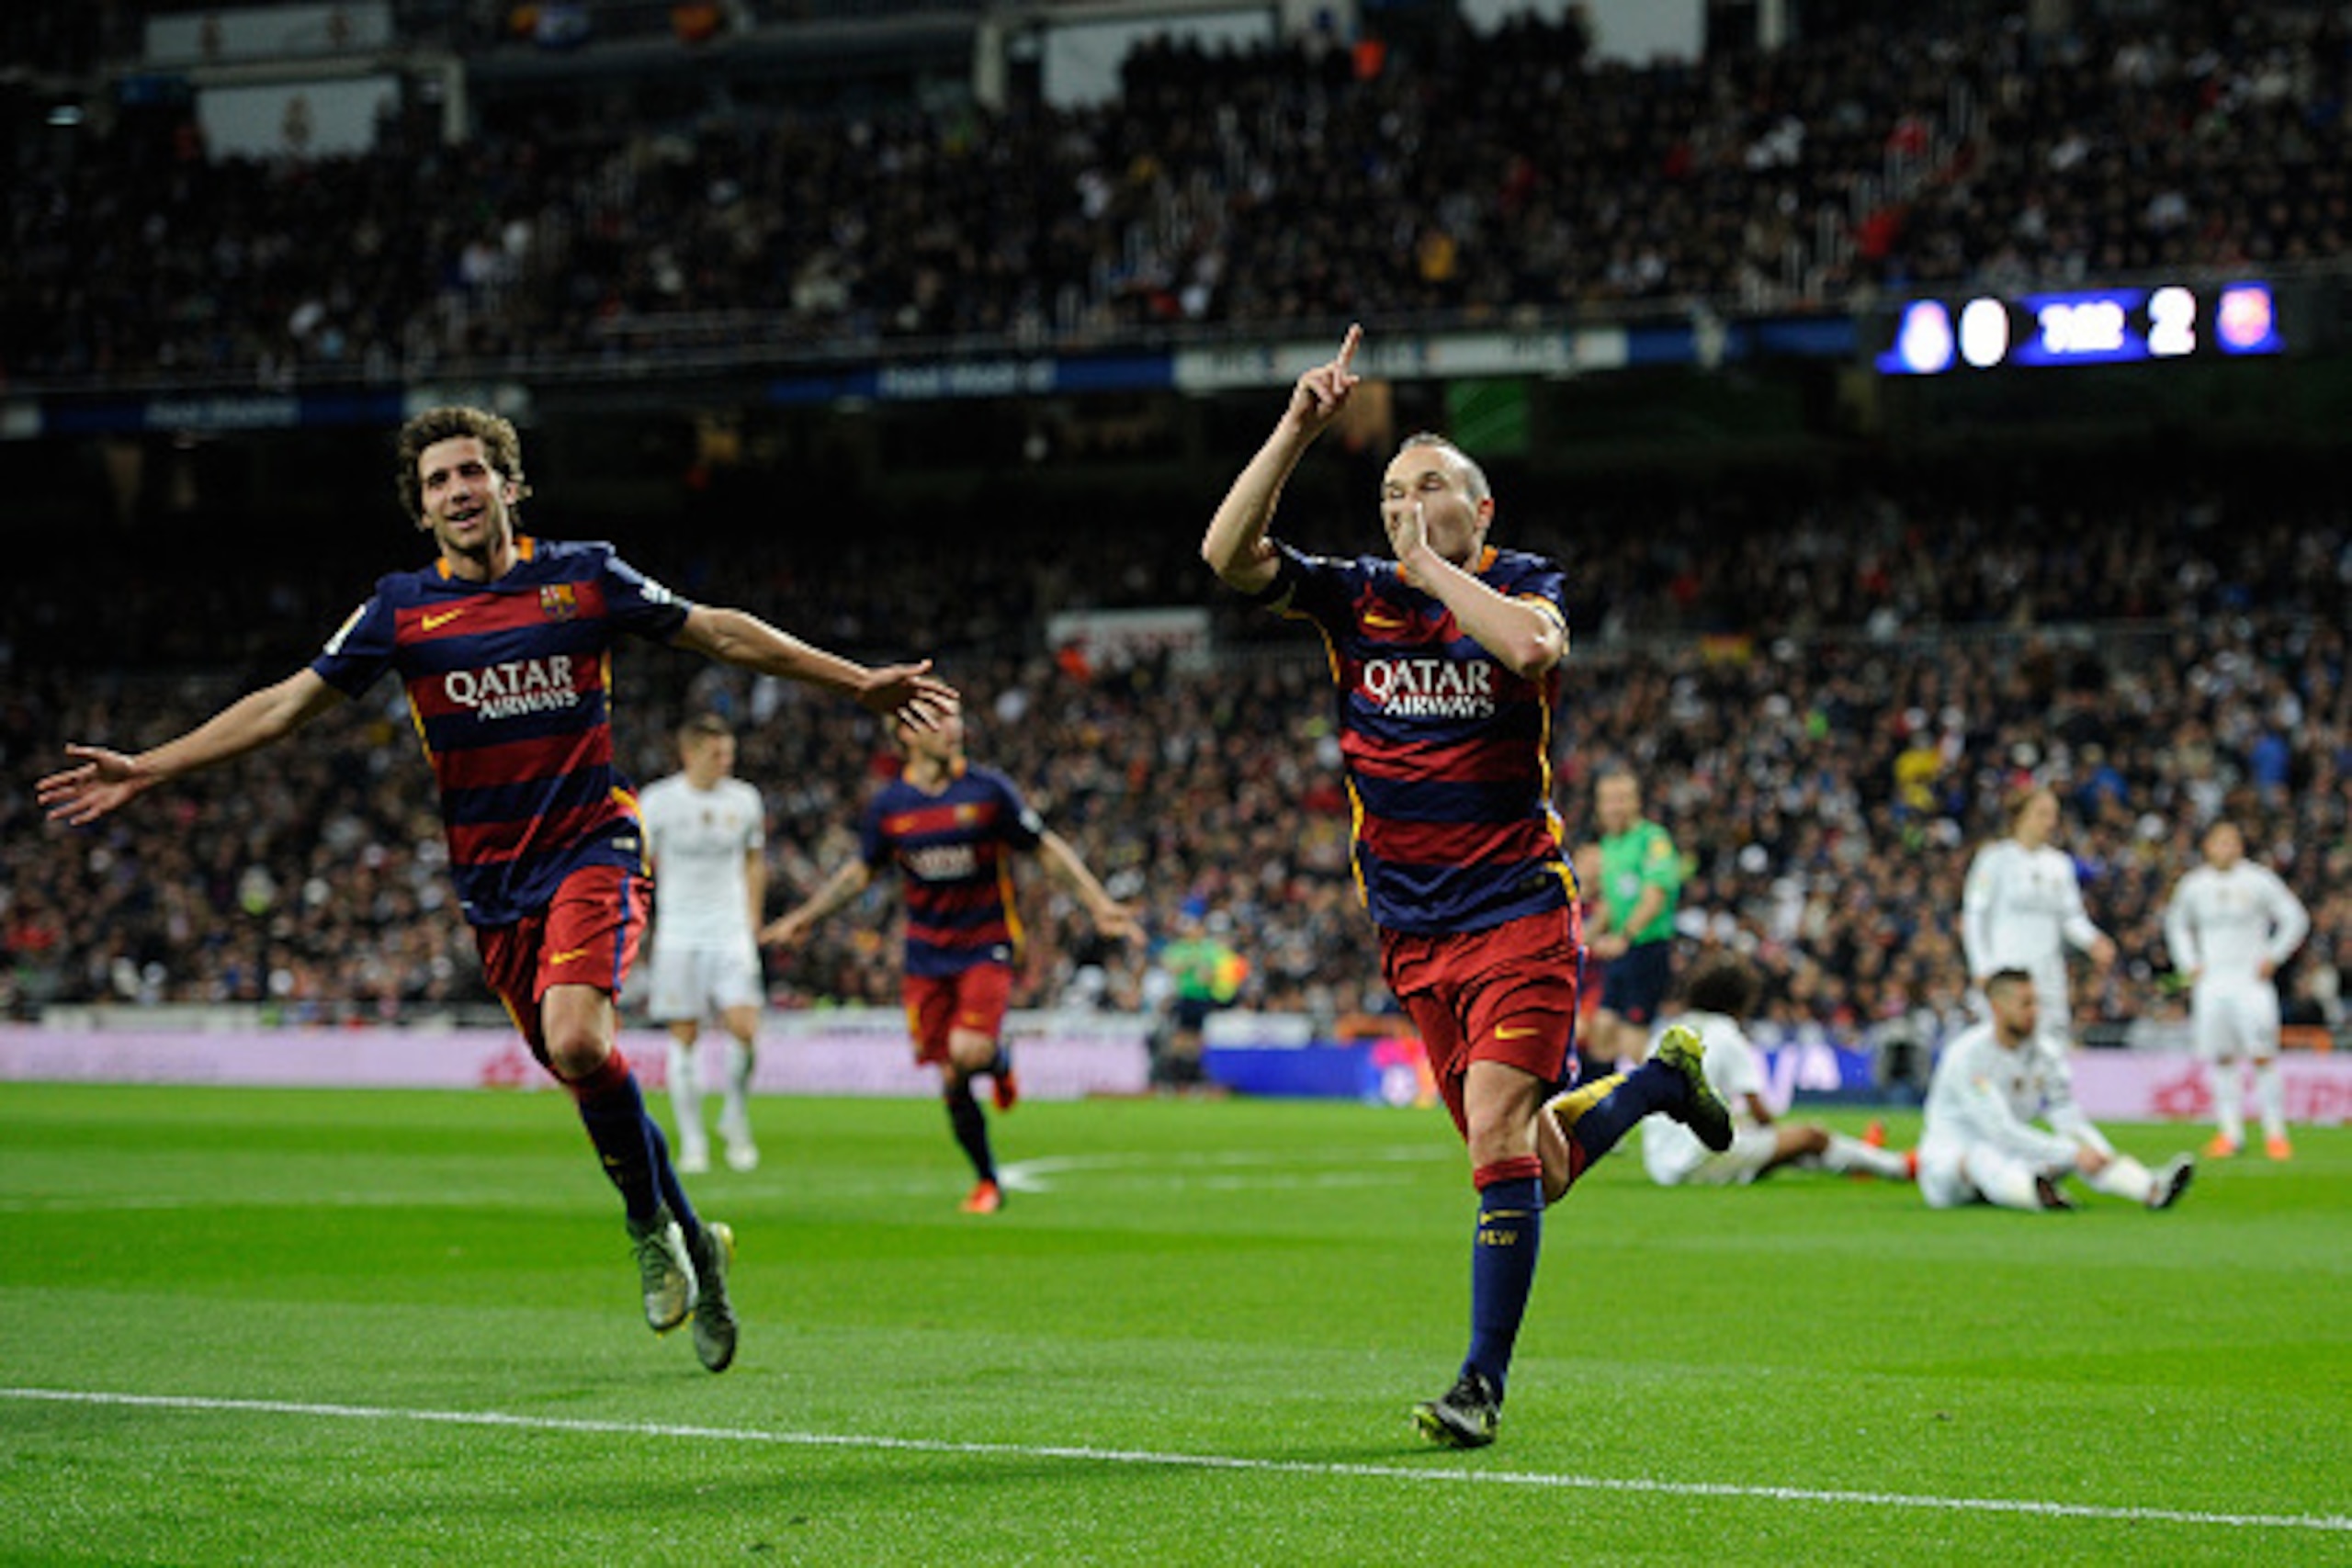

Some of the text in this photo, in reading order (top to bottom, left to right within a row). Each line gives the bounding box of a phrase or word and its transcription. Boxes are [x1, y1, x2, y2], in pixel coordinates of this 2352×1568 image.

[1960, 298, 2009, 367] 0
[2148, 286, 2197, 356] 2
[445, 655, 573, 706] QATAR
[1363, 659, 1492, 703] QATAR
[477, 689, 581, 723] AIRWAYS
[1384, 694, 1496, 718] AIRWAYS
